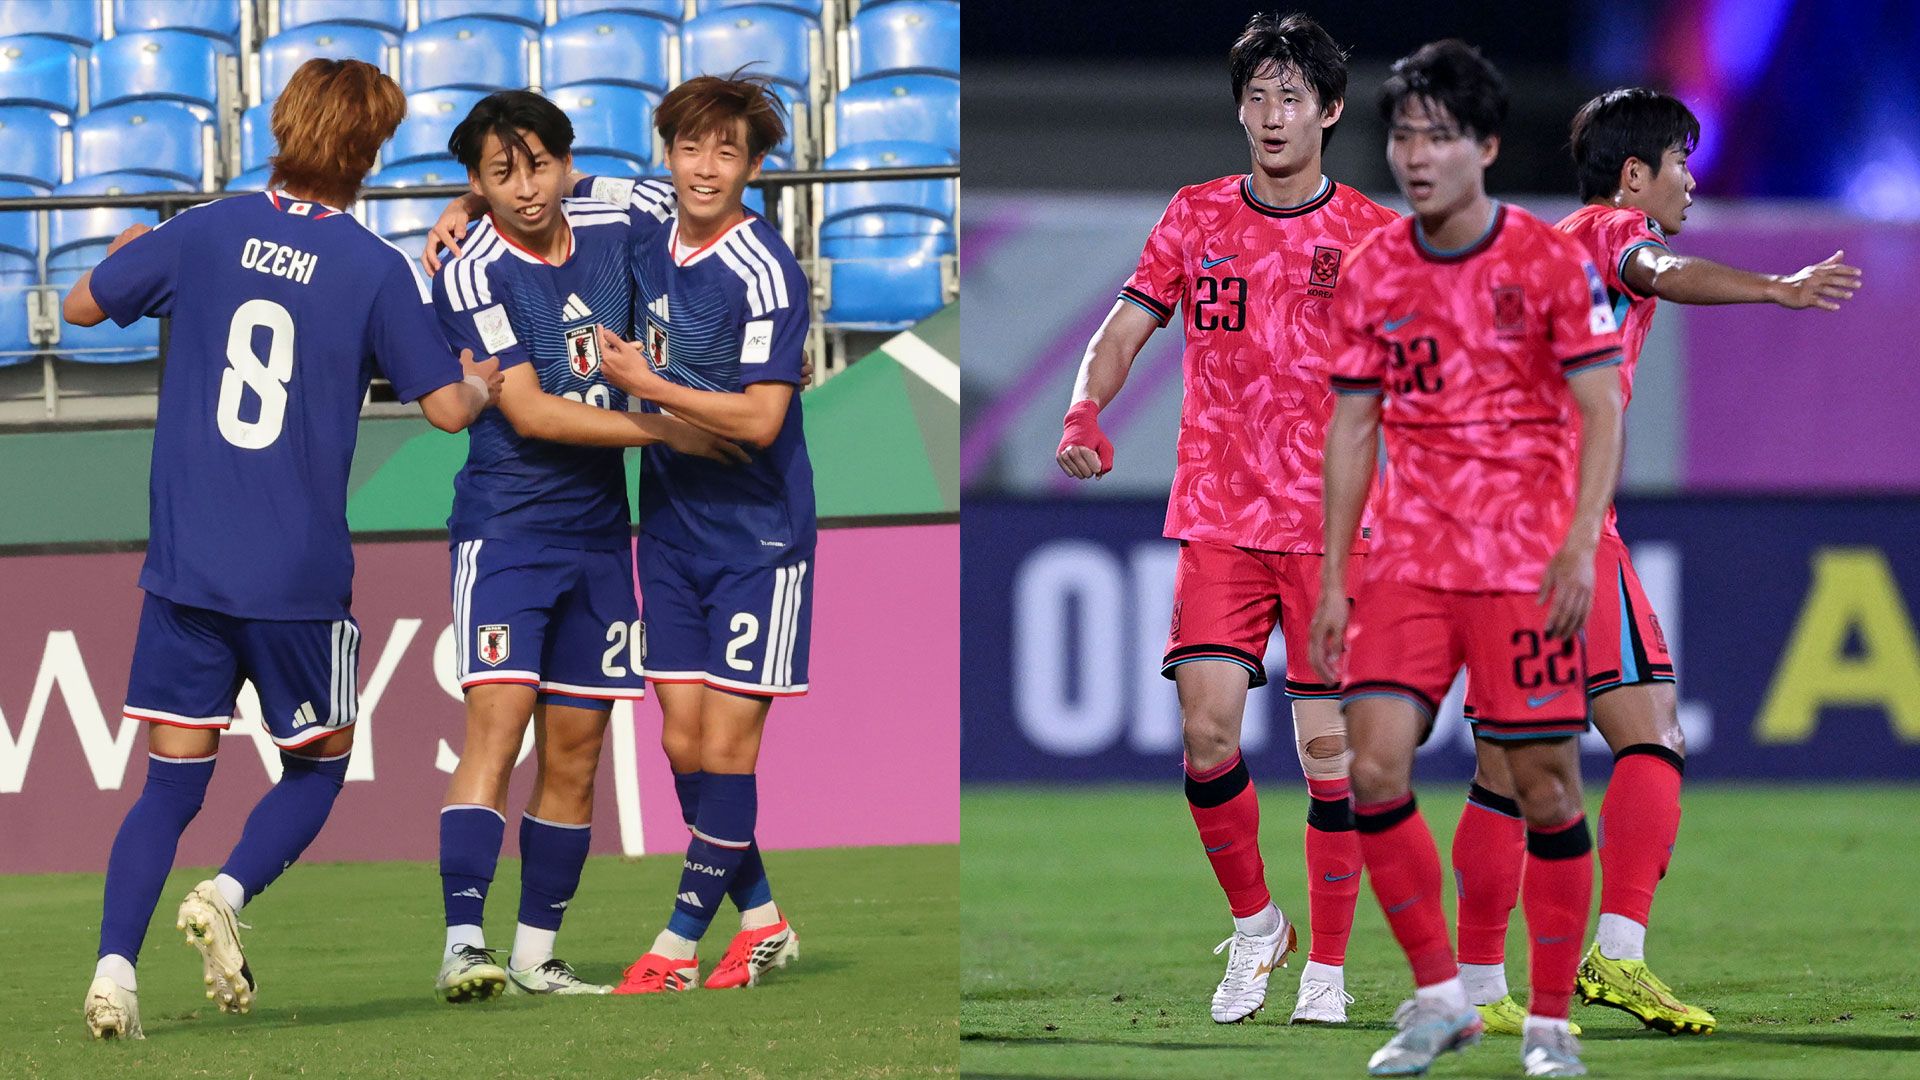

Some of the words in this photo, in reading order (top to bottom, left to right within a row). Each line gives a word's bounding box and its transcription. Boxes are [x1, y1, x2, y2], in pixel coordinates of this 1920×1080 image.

[241, 237, 318, 285] OZEKI
[1195, 276, 1247, 332] 23
[1306, 288, 1334, 299] KOREA
[217, 299, 295, 450] 8
[725, 612, 759, 672] 2
[1511, 629, 1577, 689] 22
